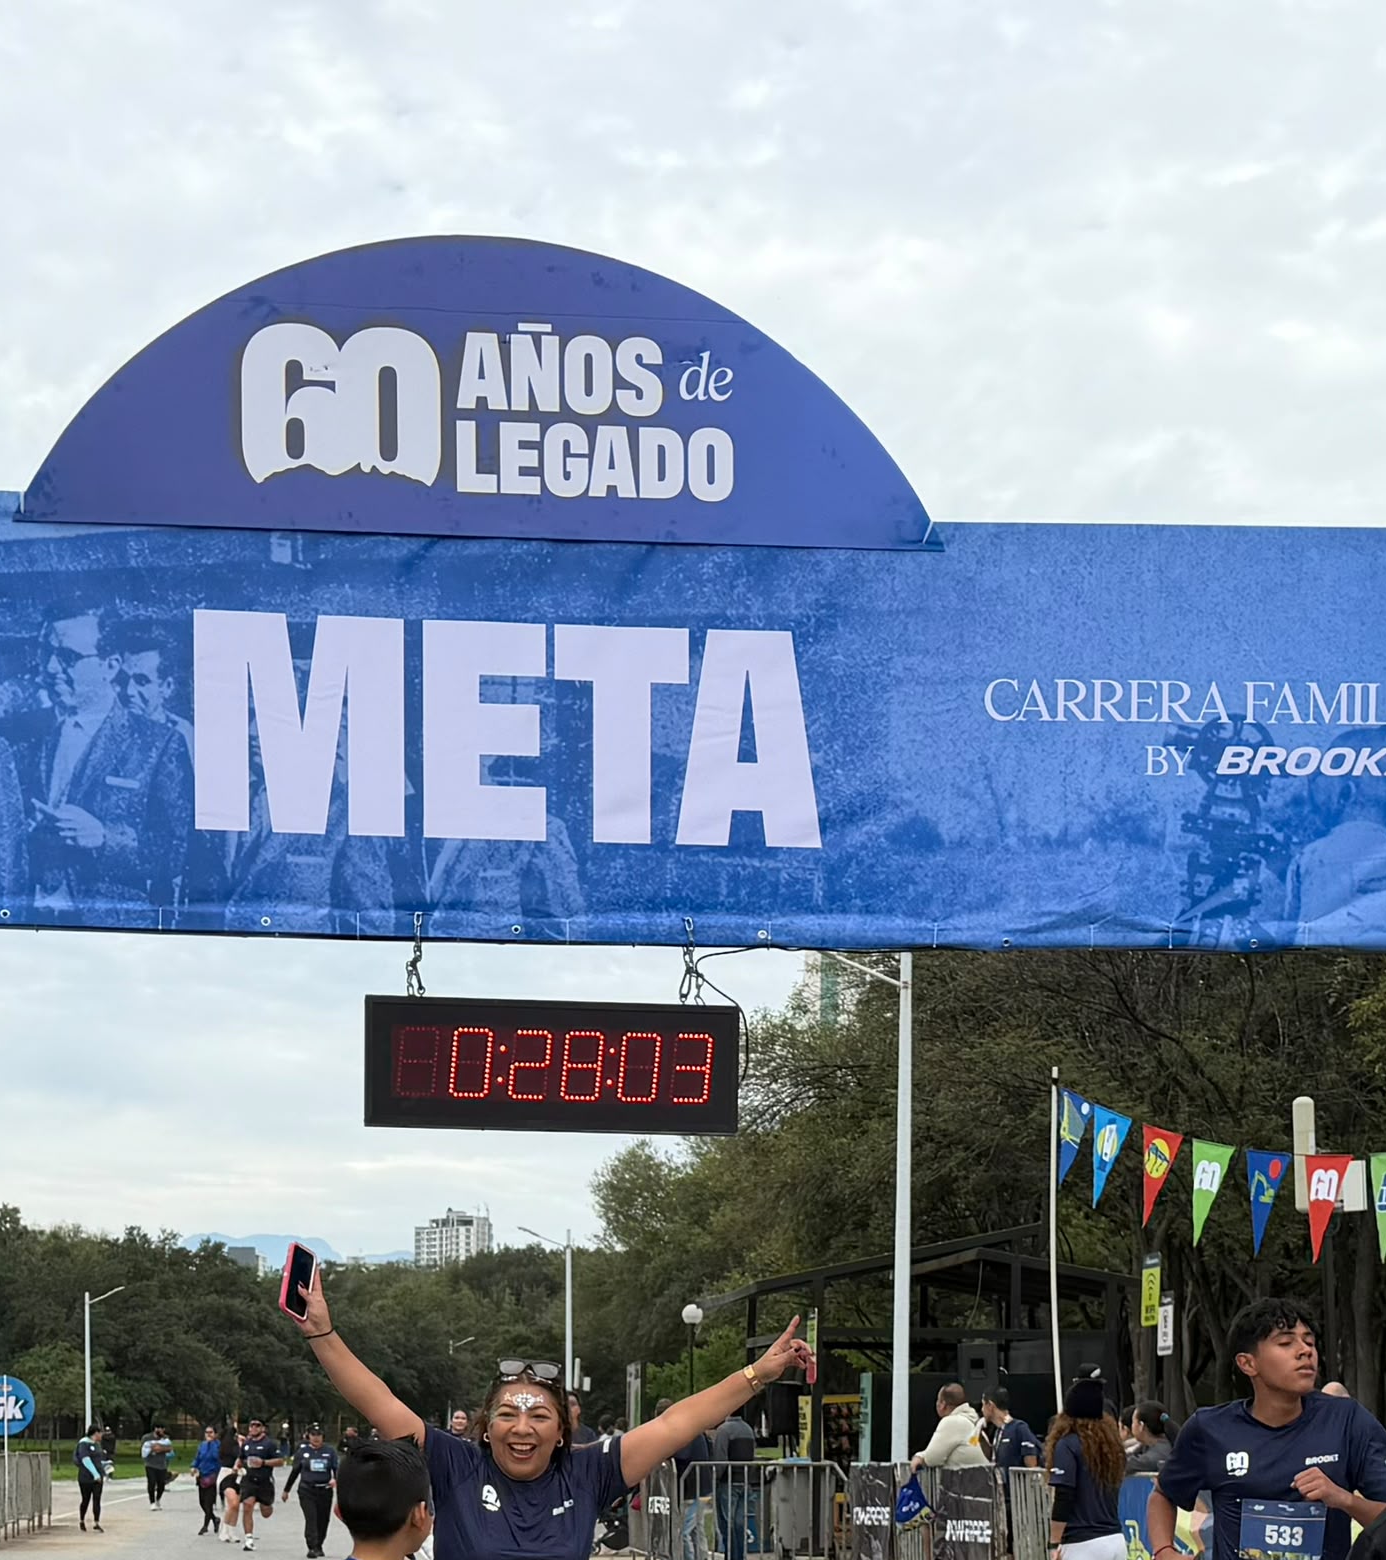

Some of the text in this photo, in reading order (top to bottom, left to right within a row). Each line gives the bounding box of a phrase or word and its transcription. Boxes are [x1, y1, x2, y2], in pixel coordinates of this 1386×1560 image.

[240, 322, 733, 487] 60 AÑOS de
[455, 419, 735, 502] LEGADO
[192, 608, 823, 849] META
[983, 678, 1232, 724] CARRERA
[1144, 745, 1195, 777] BY
[448, 1027, 714, 1103] 0:28:03
[1310, 1168, 1339, 1201] 60
[1264, 1524, 1304, 1546] 533
